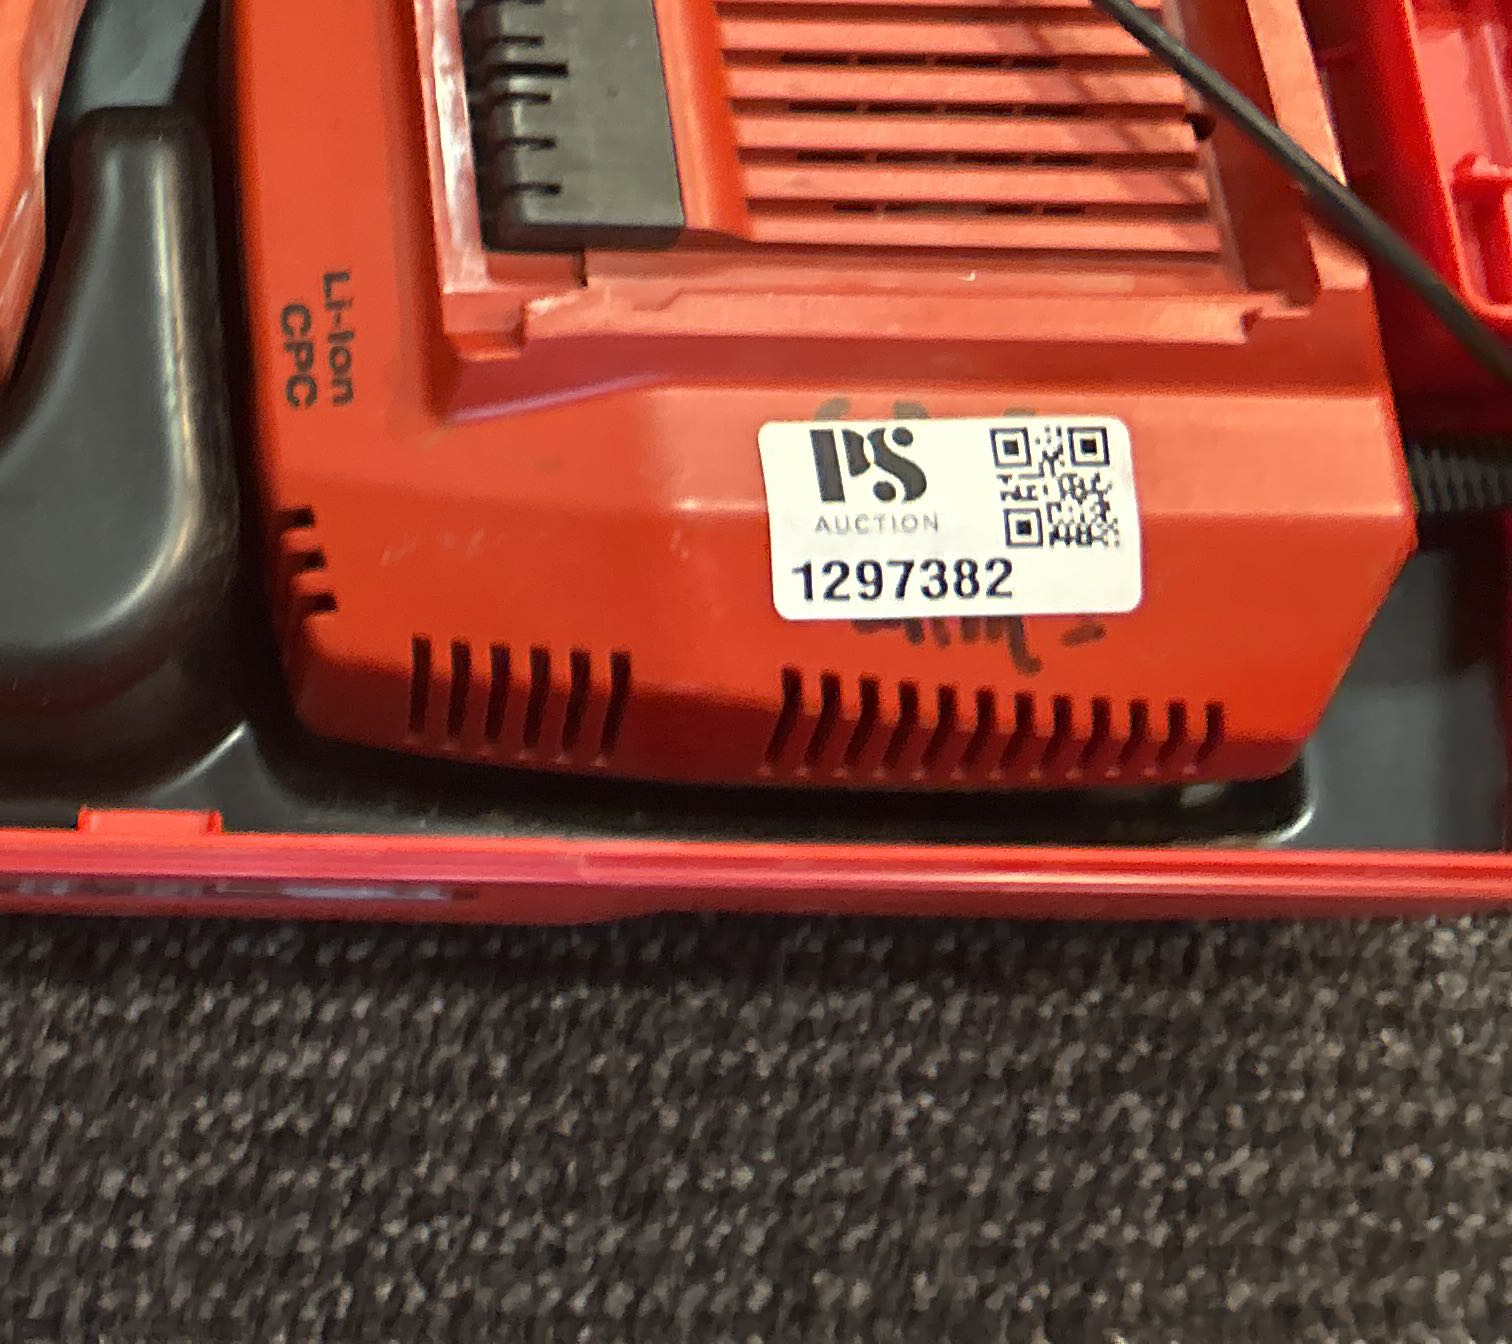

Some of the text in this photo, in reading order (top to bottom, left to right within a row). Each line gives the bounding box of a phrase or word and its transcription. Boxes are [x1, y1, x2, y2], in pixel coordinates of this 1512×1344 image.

[281, 304, 317, 408] CPC
[324, 272, 355, 406] Li-Ion
[809, 427, 928, 504] PS
[814, 511, 939, 535] AUCTION
[791, 557, 1013, 602] 1297382
